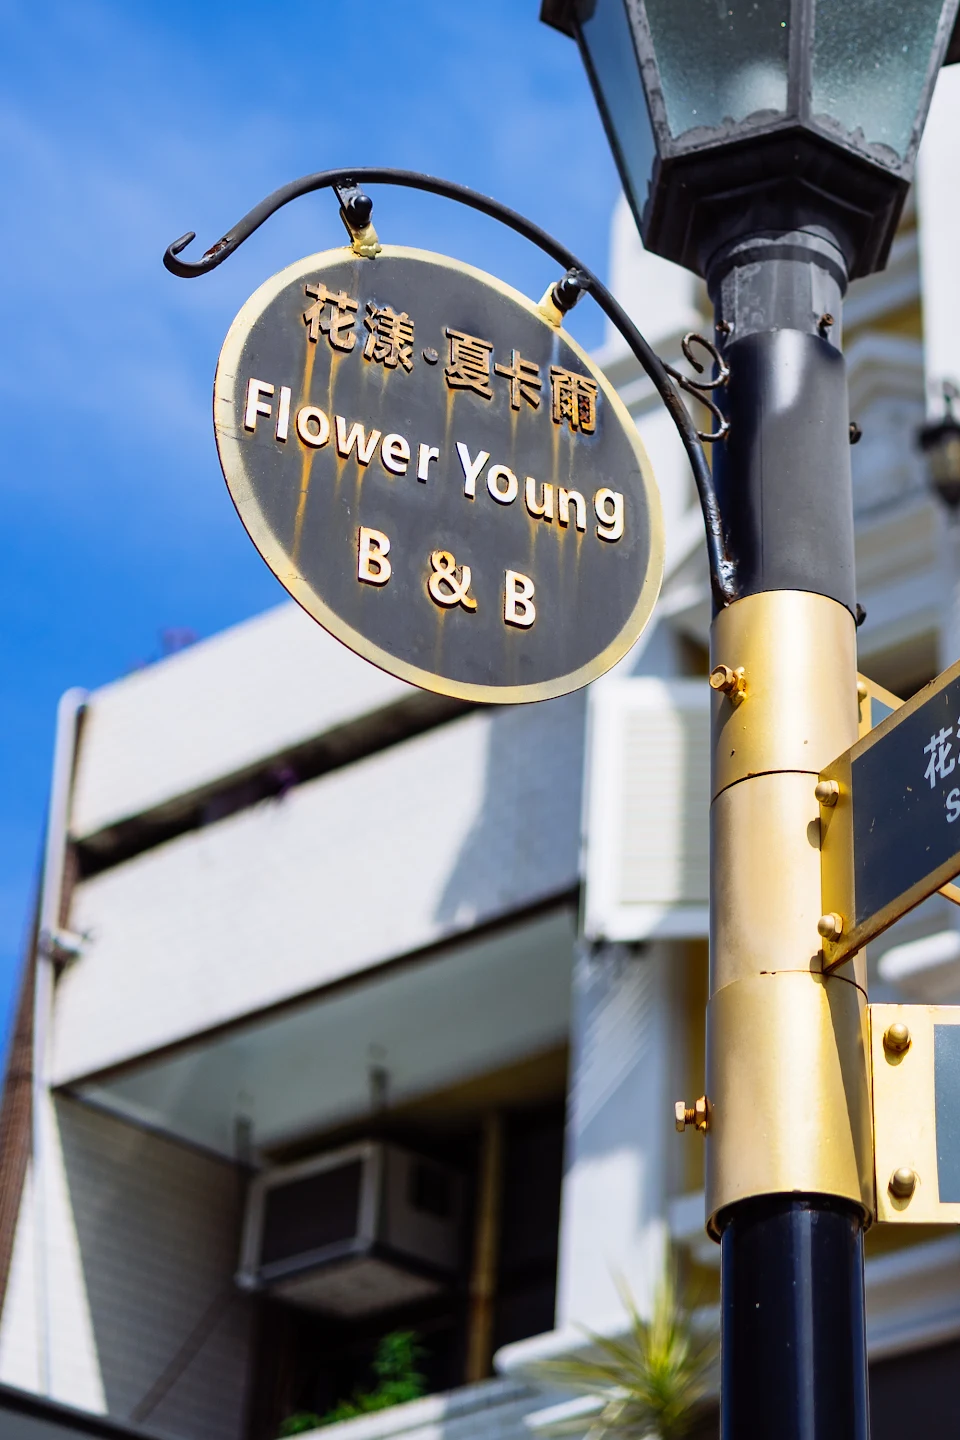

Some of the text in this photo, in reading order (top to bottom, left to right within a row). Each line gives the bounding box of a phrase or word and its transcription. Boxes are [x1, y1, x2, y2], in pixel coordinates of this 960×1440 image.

[244, 376, 625, 542] Flower Young
[356, 525, 537, 629] B & B
